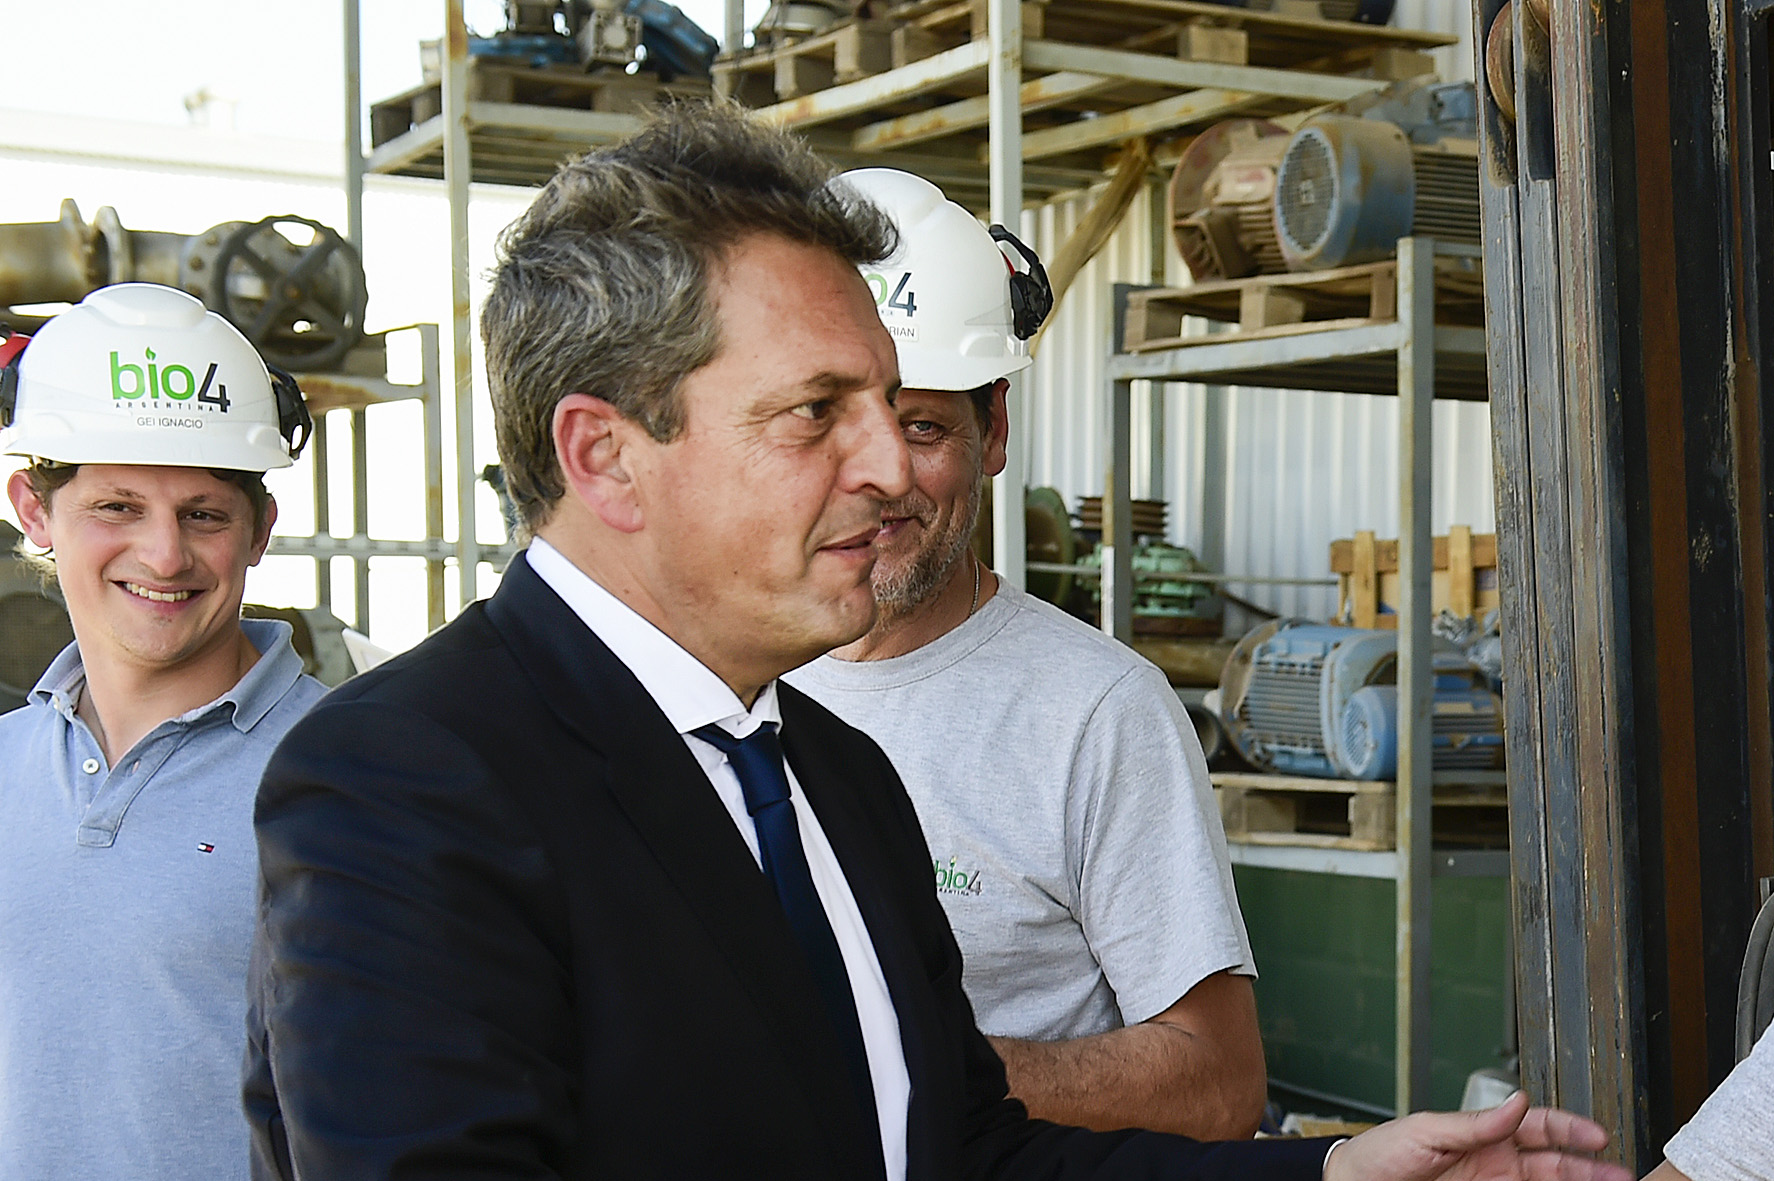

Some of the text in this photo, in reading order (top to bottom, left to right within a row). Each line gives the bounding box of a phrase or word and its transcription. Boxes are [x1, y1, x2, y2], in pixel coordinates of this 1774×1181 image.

[109, 346, 231, 413] bio4
[115, 402, 214, 412] ARGENTINA
[136, 416, 203, 429] GEI IGNACIO
[935, 855, 982, 896] bio4
